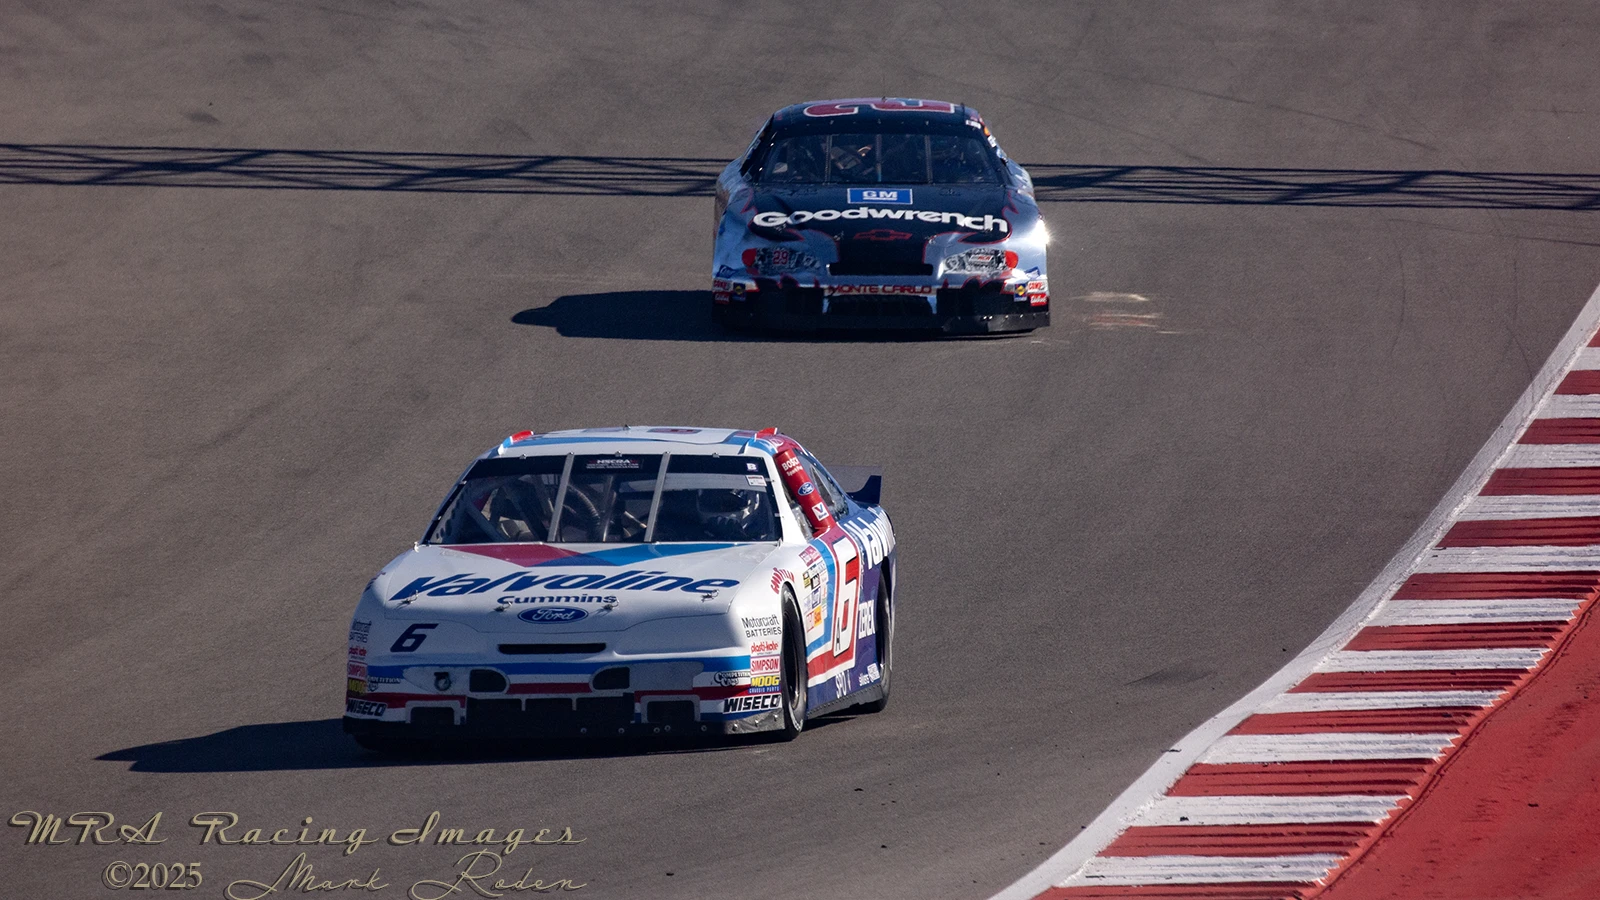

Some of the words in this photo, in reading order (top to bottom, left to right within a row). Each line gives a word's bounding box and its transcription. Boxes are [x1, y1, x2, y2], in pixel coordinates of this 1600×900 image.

[863, 189, 898, 200] GM
[753, 206, 1009, 232] Goodwrench
[773, 250, 789, 265] 29
[828, 285, 879, 294] MONTE
[882, 285, 932, 294] CARLO
[389, 571, 740, 601] Valvoline
[498, 594, 618, 604] Cummins
[533, 609, 574, 620] Ford
[741, 614, 779, 629] Motorcraft
[389, 623, 439, 652] 6
[745, 627, 782, 638] BATTERIES
[751, 659, 779, 672] SIMPSON
[751, 676, 779, 688] MOOG
[347, 700, 387, 717] WISECO
[724, 694, 779, 713] WISECO
